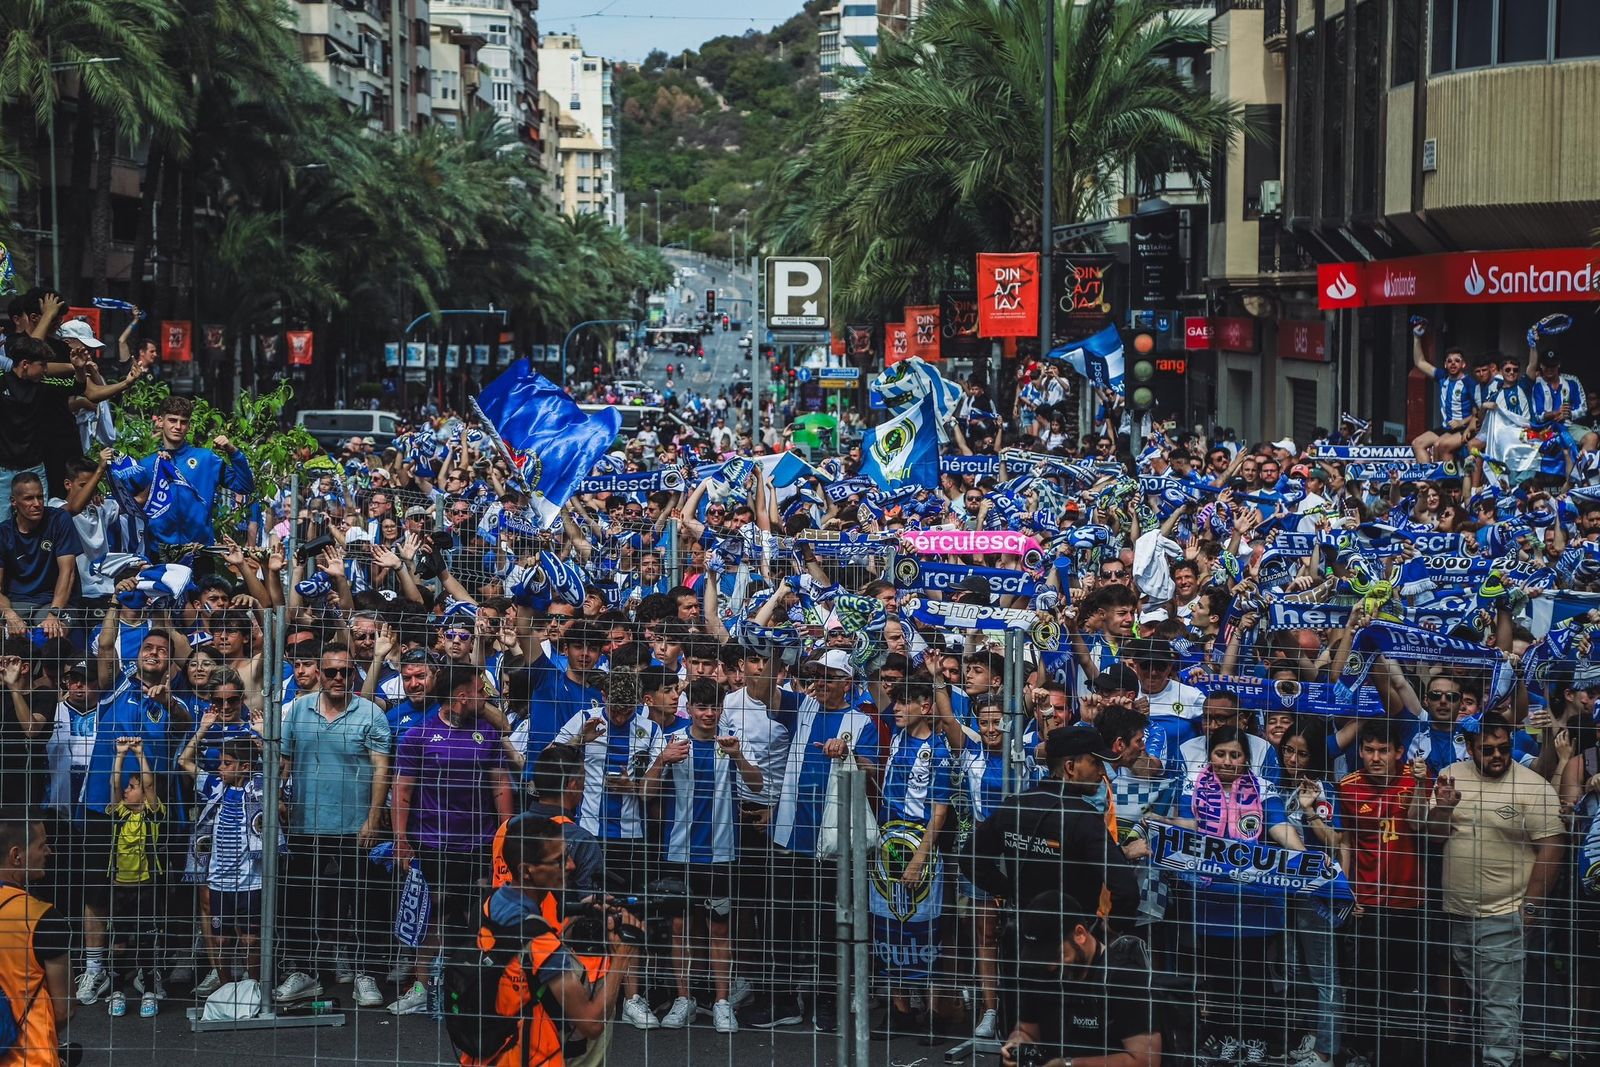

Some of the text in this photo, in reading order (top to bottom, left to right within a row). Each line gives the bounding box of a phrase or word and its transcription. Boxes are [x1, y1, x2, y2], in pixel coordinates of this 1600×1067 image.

[995, 268, 1020, 281] DIN
[774, 262, 822, 315] P
[994, 282, 1021, 295] AST
[1318, 447, 1414, 457] LA ROMANA
[1226, 685, 1263, 695] RFEF
[1380, 817, 1399, 843] 21
[1004, 840, 1060, 856] NACIONAL
[1156, 824, 1338, 880] HERCULES
[1186, 858, 1222, 875] club
[1229, 868, 1250, 882] de
